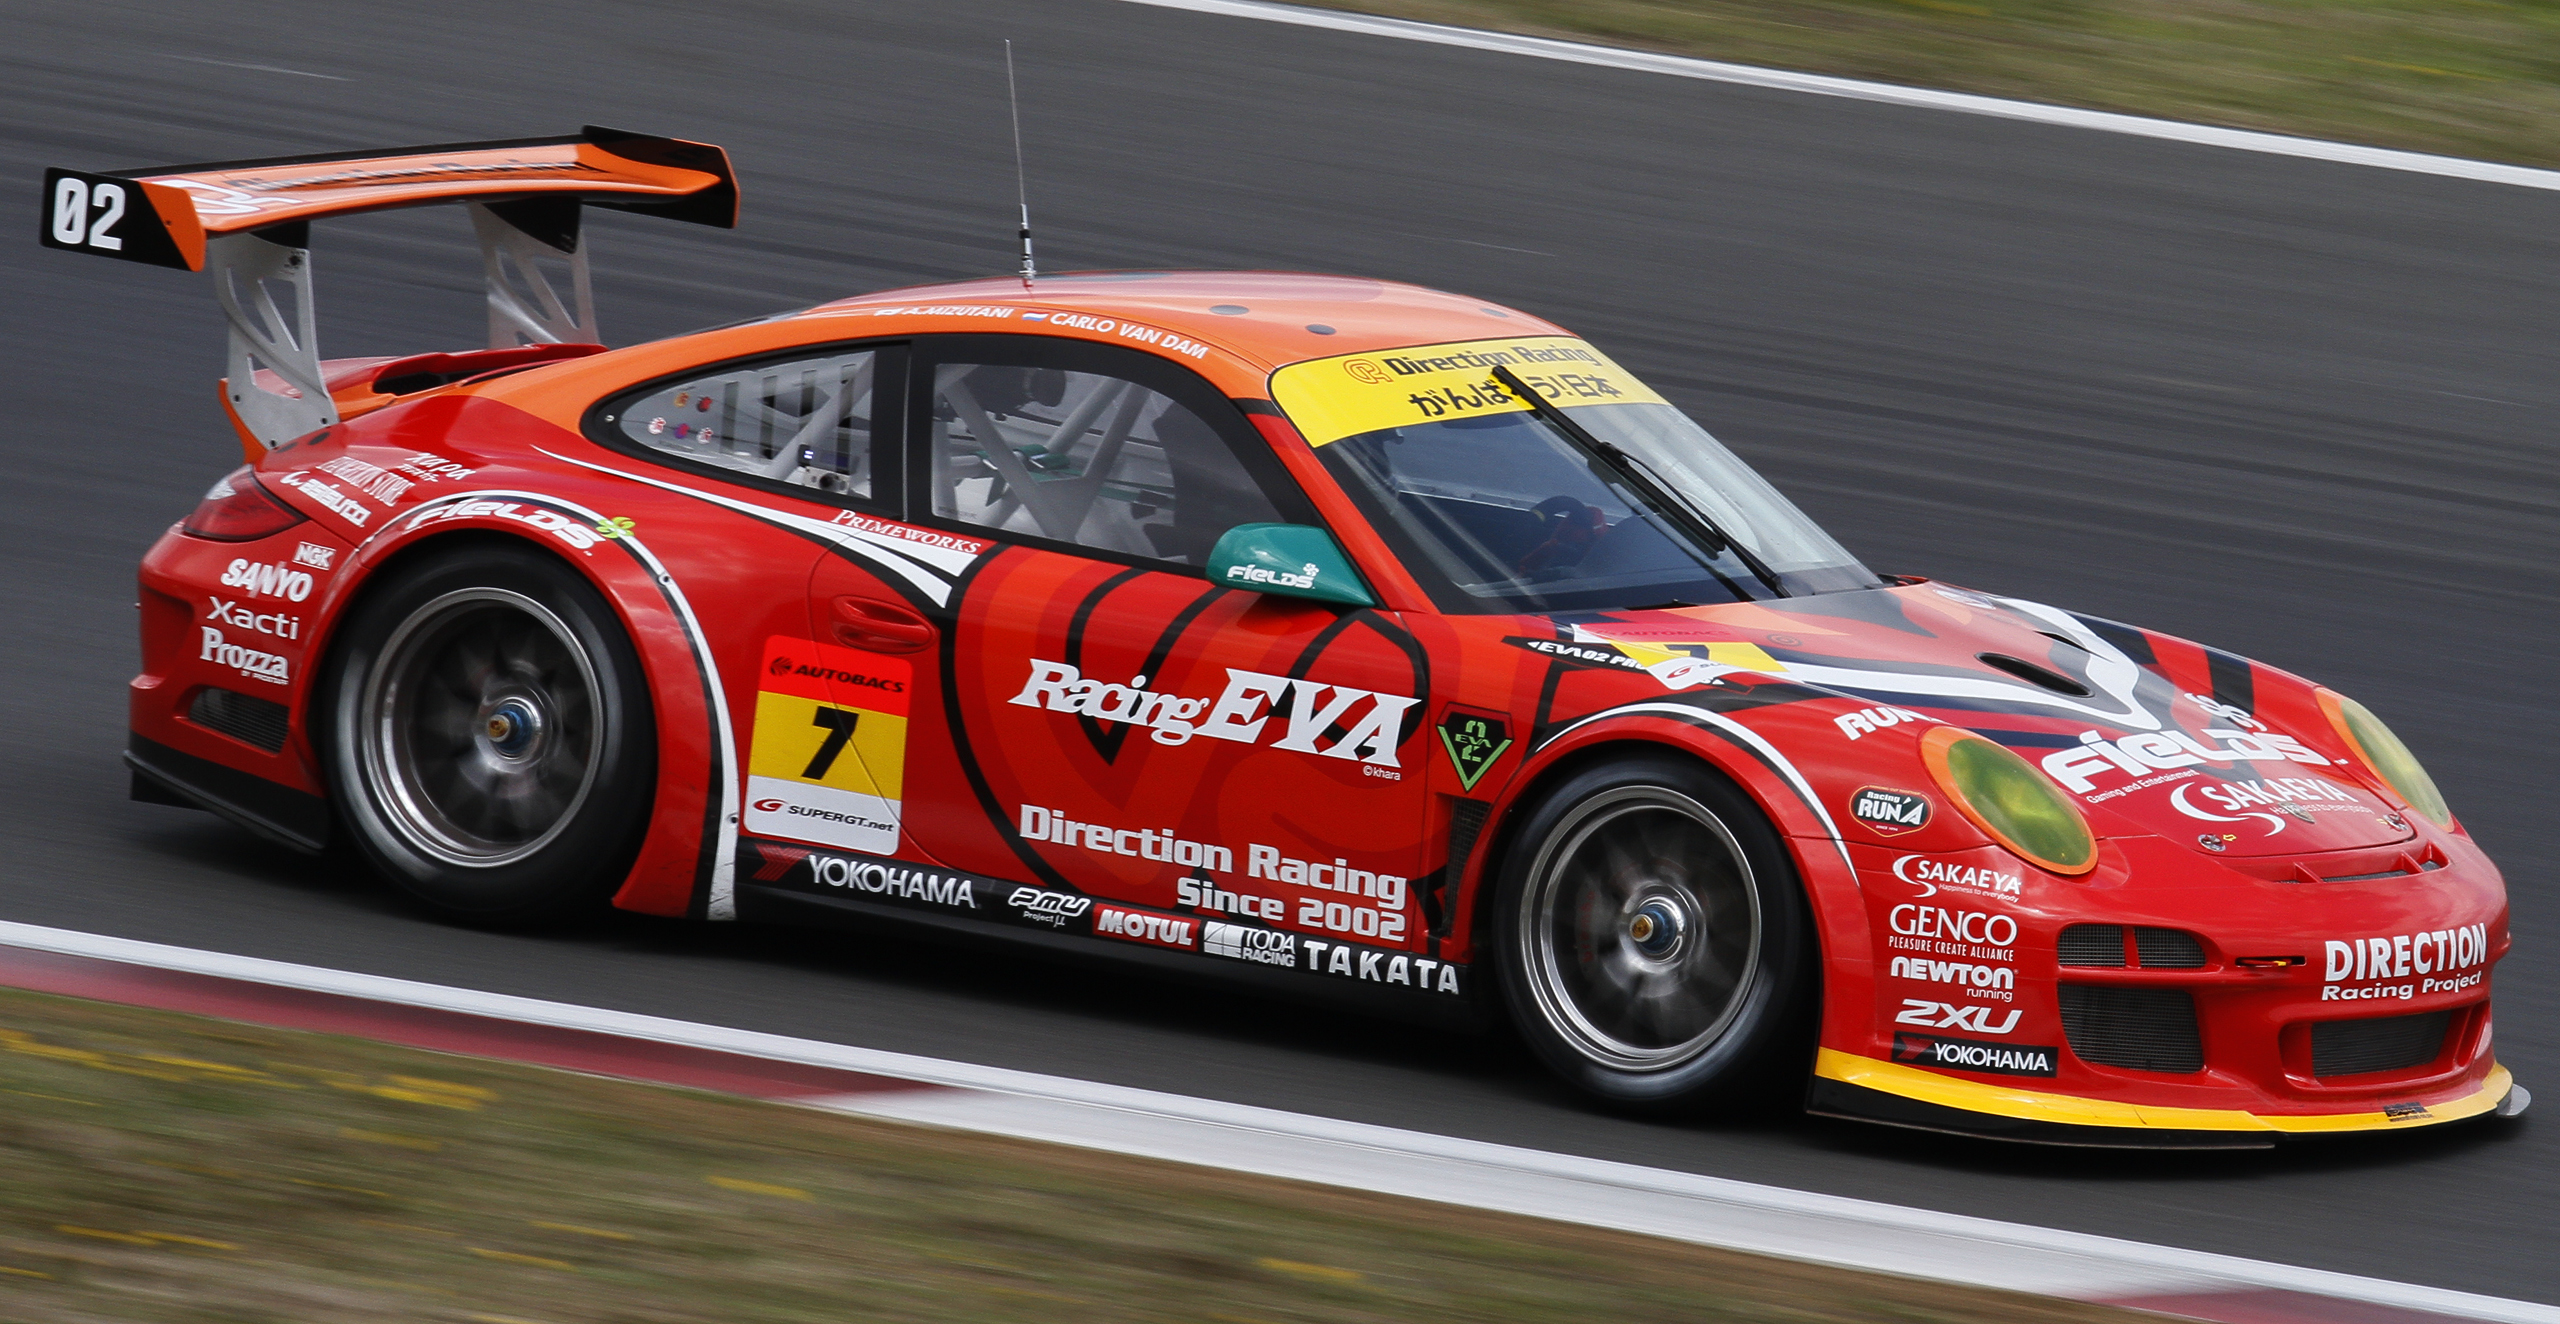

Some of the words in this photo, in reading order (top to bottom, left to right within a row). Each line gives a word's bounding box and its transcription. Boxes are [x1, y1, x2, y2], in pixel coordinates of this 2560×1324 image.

[52, 177, 126, 251] 02
[1049, 312, 1116, 333] CARLO
[1118, 323, 1160, 345] VAN
[1160, 333, 1209, 360] DAM
[1384, 346, 1515, 377] Direction
[1509, 344, 1602, 368] Racing
[1408, 373, 1624, 417] がんばう!日本
[294, 543, 336, 570] NGK
[220, 558, 314, 603] SANYO
[206, 596, 299, 640] Xacti
[200, 626, 290, 680] Prozza
[795, 664, 905, 694] AUTOBACS
[1007, 658, 1210, 746] Racing
[1192, 668, 1422, 768] EVA
[801, 705, 860, 781] 7
[1867, 791, 1900, 803] Racing
[2200, 777, 2359, 811] SAKAEYA
[788, 804, 894, 833] SUPERGT.net
[1020, 804, 1233, 874] Direction
[1247, 843, 1408, 912] Racing
[808, 854, 976, 910] YOKOHAMA
[1916, 858, 2022, 896] SAKAEYA
[1023, 911, 1054, 923] Project
[1097, 909, 1193, 946] MOTUL
[1176, 876, 1286, 922] Since
[1297, 897, 1406, 943] 2002
[1889, 903, 2018, 947] GENCO
[1242, 927, 1296, 954] TODA
[1242, 947, 1295, 968] RACING
[1888, 936, 1932, 952] PLEASURE
[1935, 943, 1967, 957] CREATE
[1970, 946, 2015, 962] ALLIANCE
[2324, 922, 2488, 982] DIRECTION
[1303, 940, 1460, 996] TAKATA
[2321, 982, 2414, 1001] Racing
[2421, 971, 2482, 994] Project
[1966, 987, 2013, 1003] running
[1894, 998, 2023, 1034] 2XU
[1934, 1042, 2049, 1071] YOKOHAMA
